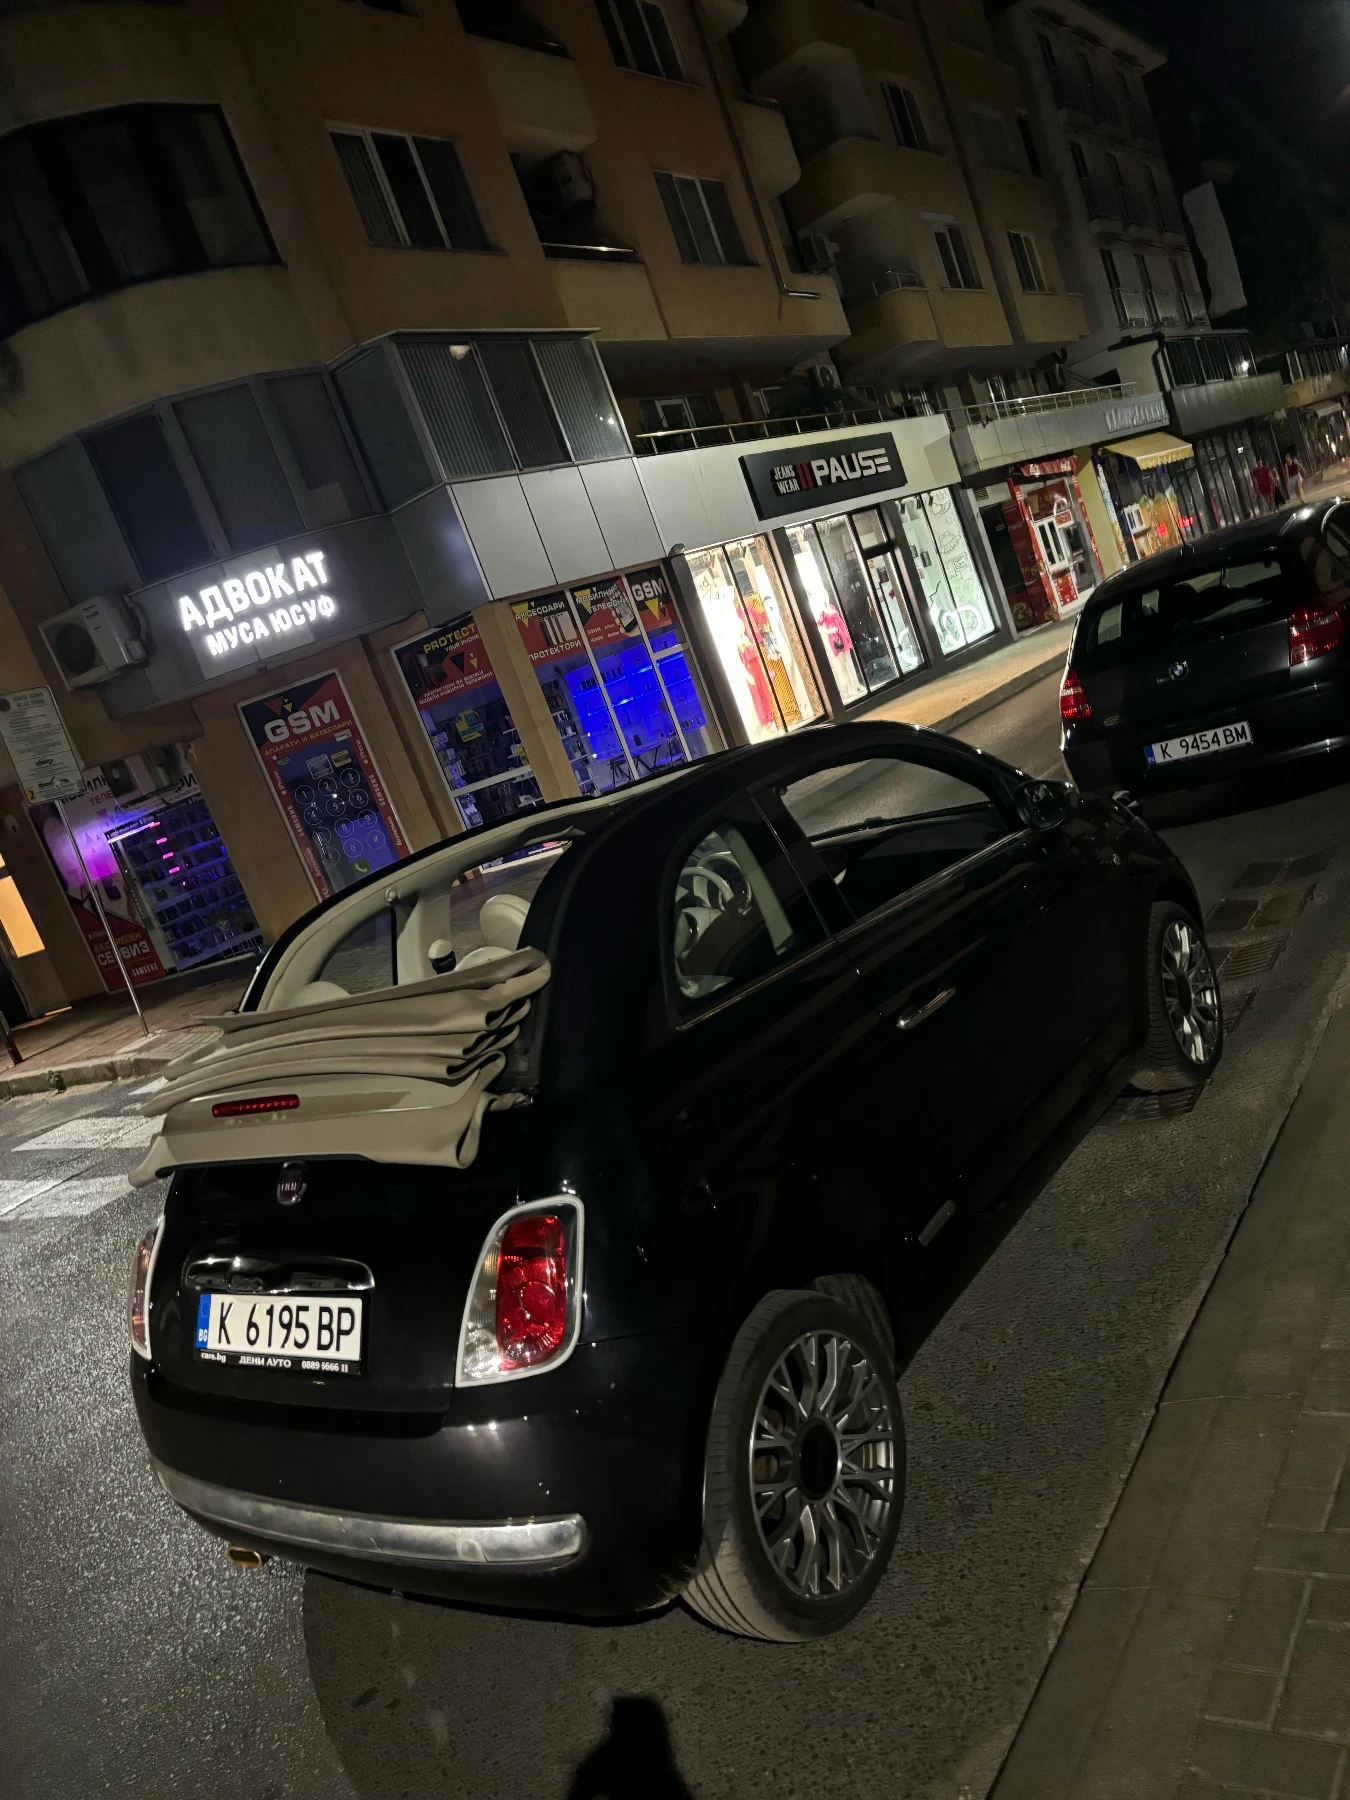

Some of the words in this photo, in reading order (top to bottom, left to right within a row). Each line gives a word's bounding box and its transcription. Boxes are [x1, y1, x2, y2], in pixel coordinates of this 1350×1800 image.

[773, 464, 796, 481] JEANS
[810, 447, 892, 486] PAUSE
[776, 479, 801, 495] WEAR
[179, 551, 328, 631] АДВОКАТ
[631, 577, 668, 602] GSM
[515, 601, 566, 621] АКСЕСОАРИ
[205, 617, 270, 656] МУСА
[269, 595, 335, 633] ЮСУФ
[423, 622, 476, 654] PROTECT
[444, 643, 460, 652] YOUR
[528, 640, 582, 661] ПРОТЕКТОРИ
[264, 699, 341, 743] GSM
[264, 739, 300, 756] АПАРАТИ
[309, 719, 353, 740] АКСЕСОАРИ
[1160, 742, 1172, 759] K
[1179, 731, 1221, 755] 9454
[1222, 724, 1248, 745] BM
[324, 782, 331, 790] 2
[347, 772, 354, 781] 3
[90, 791, 114, 806] ТЕЛЕ
[356, 794, 363, 802] 6
[94, 931, 142, 953] ЕКСРЕСЕН
[97, 940, 150, 966] СЕВИЗ
[198, 1328, 208, 1342] BG
[218, 1302, 234, 1345] K
[246, 1303, 310, 1350] 6195
[316, 1305, 356, 1352] BP
[201, 1352, 227, 1363] cars.bg
[238, 1355, 265, 1366] ДЕНИ
[266, 1357, 292, 1368] АУТО
[301, 1361, 320, 1370] 0889
[340, 1363, 349, 1373] 11
